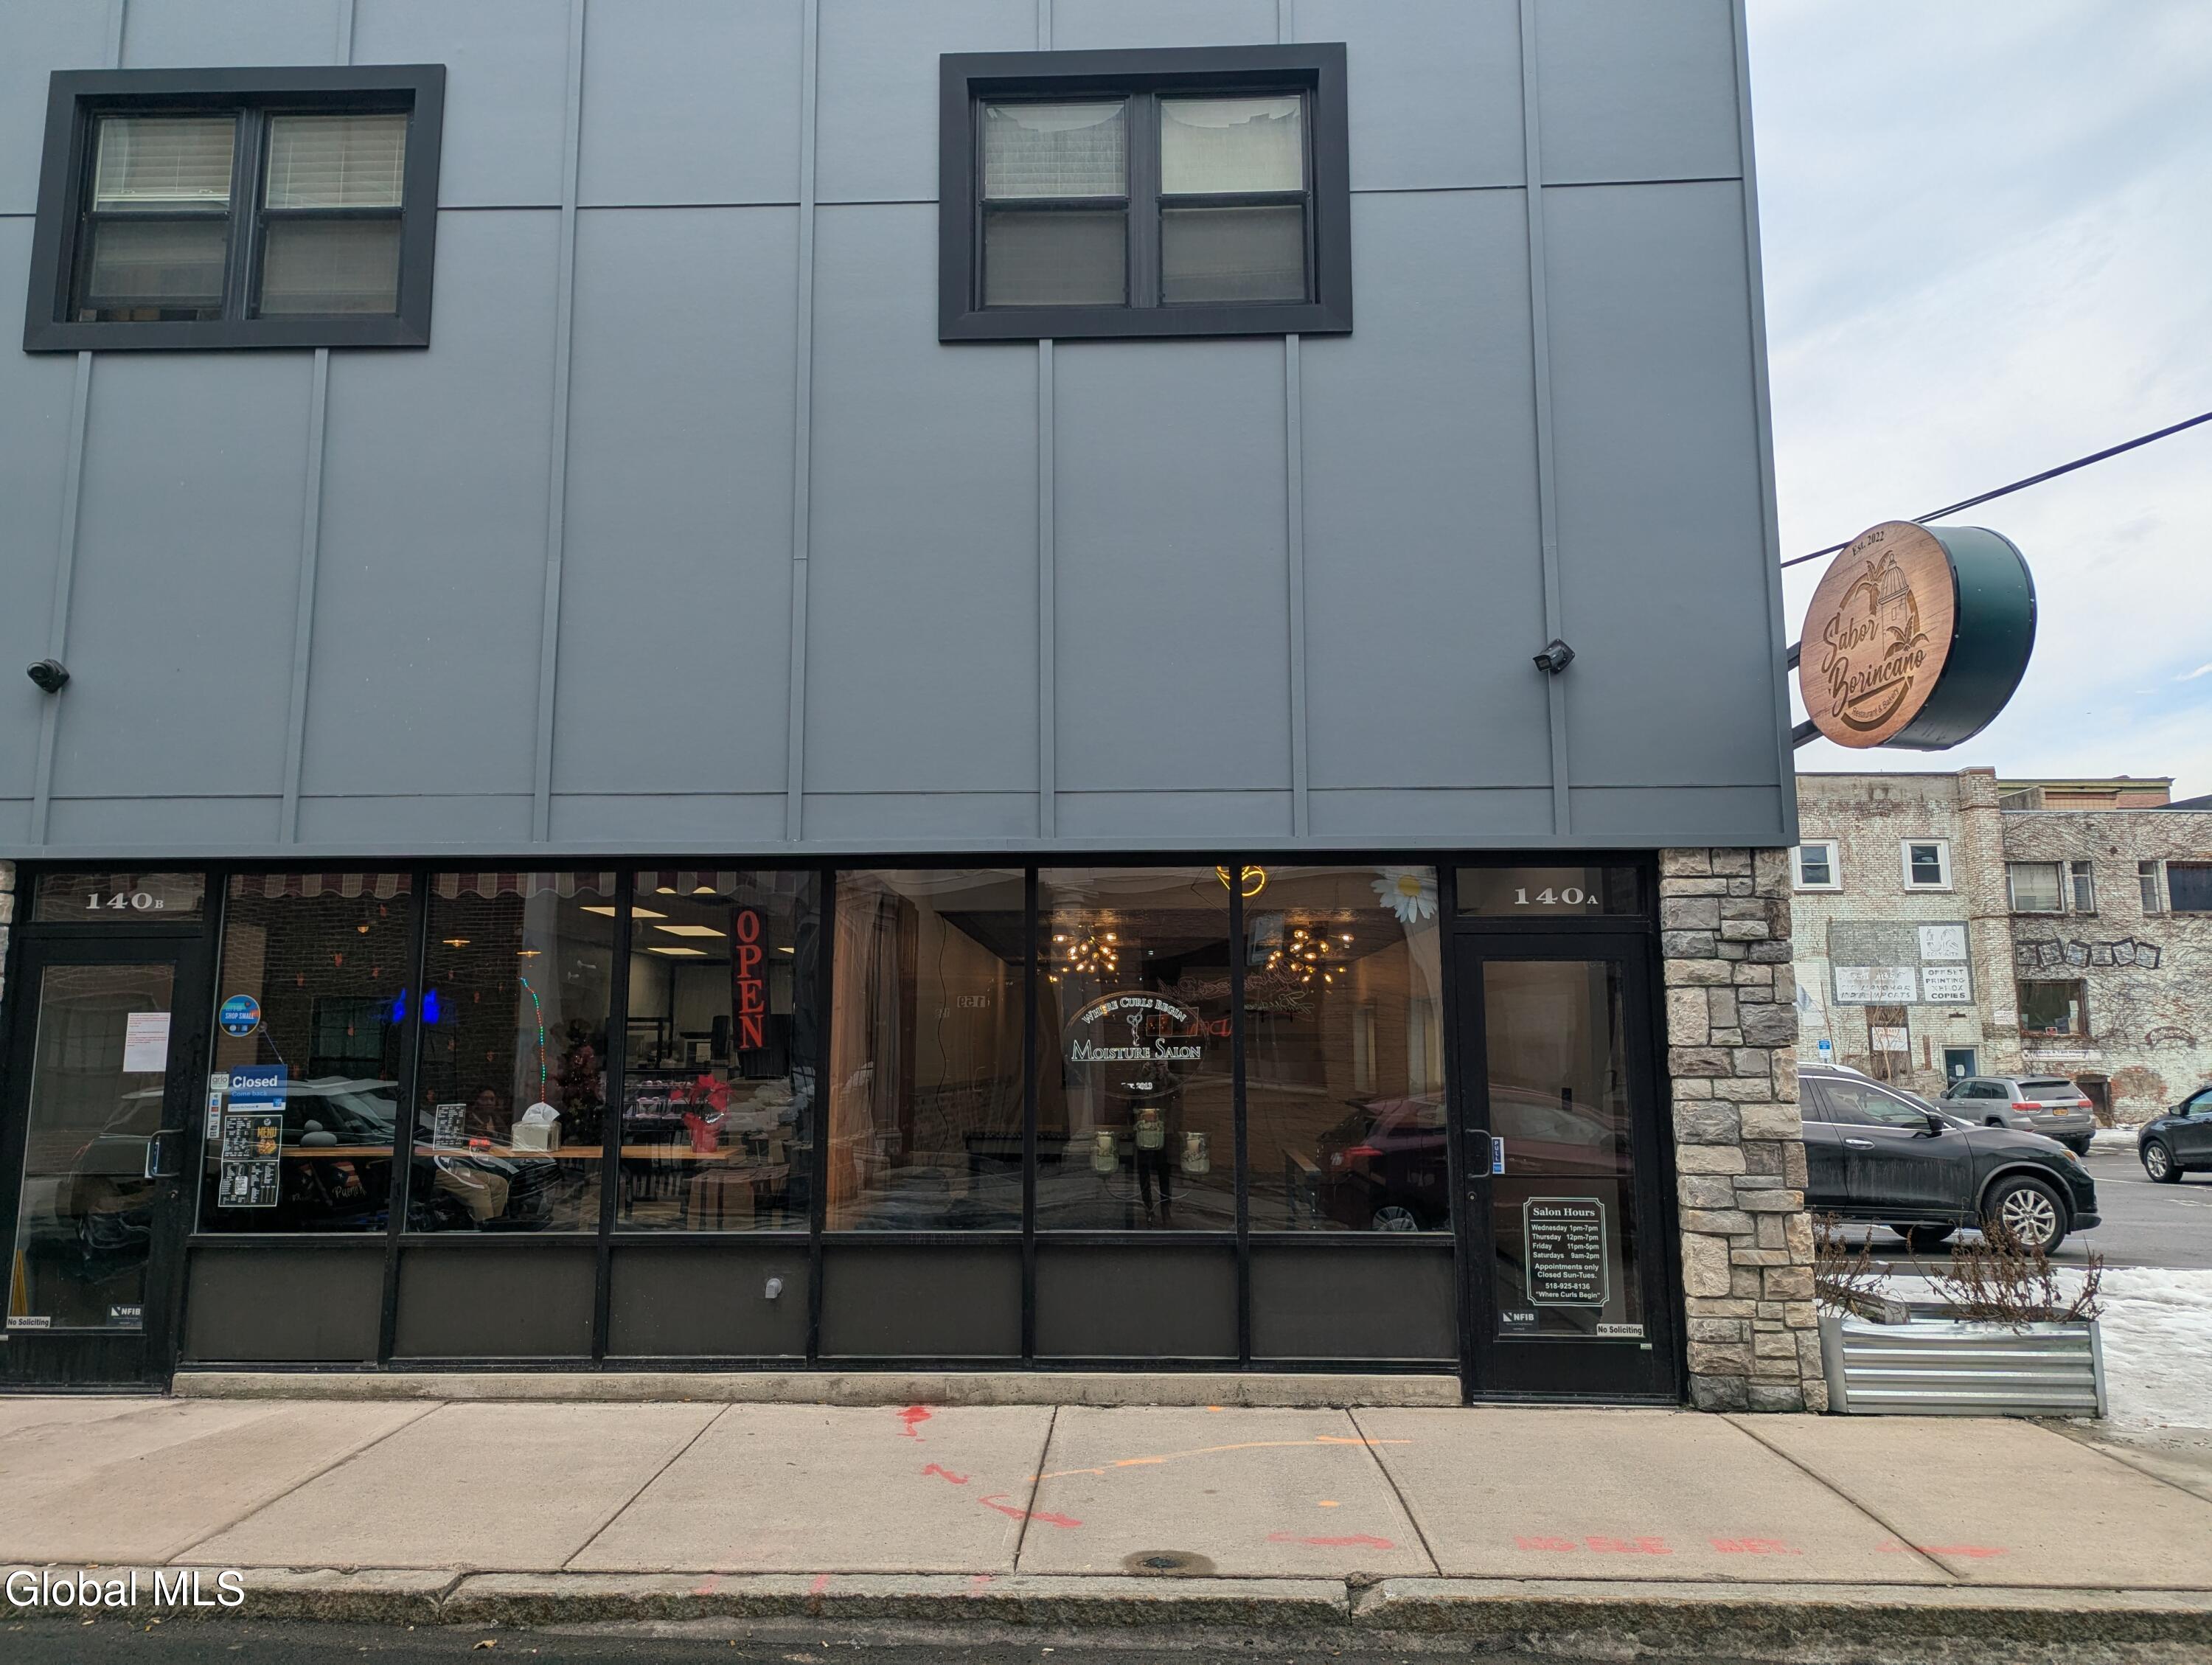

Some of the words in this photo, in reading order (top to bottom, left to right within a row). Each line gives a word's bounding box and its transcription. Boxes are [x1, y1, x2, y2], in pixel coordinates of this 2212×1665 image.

[1852, 541, 1865, 556] Est.
[1868, 531, 1884, 546] 2022
[1822, 612, 1879, 673] Sabor
[1829, 650, 1927, 717] Borincano
[1852, 707, 1877, 717] Restaurant
[1882, 687, 1899, 709] Bakery
[737, 911, 765, 1049] OPEN
[1082, 1000, 1118, 1024] WHERE
[1120, 997, 1152, 1008] CURLS
[1156, 999, 1187, 1023] BEGIN
[232, 1075, 277, 1088] Closed
[257, 1127, 276, 1137] MENU
[1533, 1207, 1561, 1216] Salon
[1564, 1208, 1595, 1216] Hours
[1531, 1224, 1567, 1232] Wednesday
[1533, 1242, 1552, 1251] Friday
[18, 1318, 49, 1327] Soliciting
[1610, 1327, 1642, 1335] Soliciting
